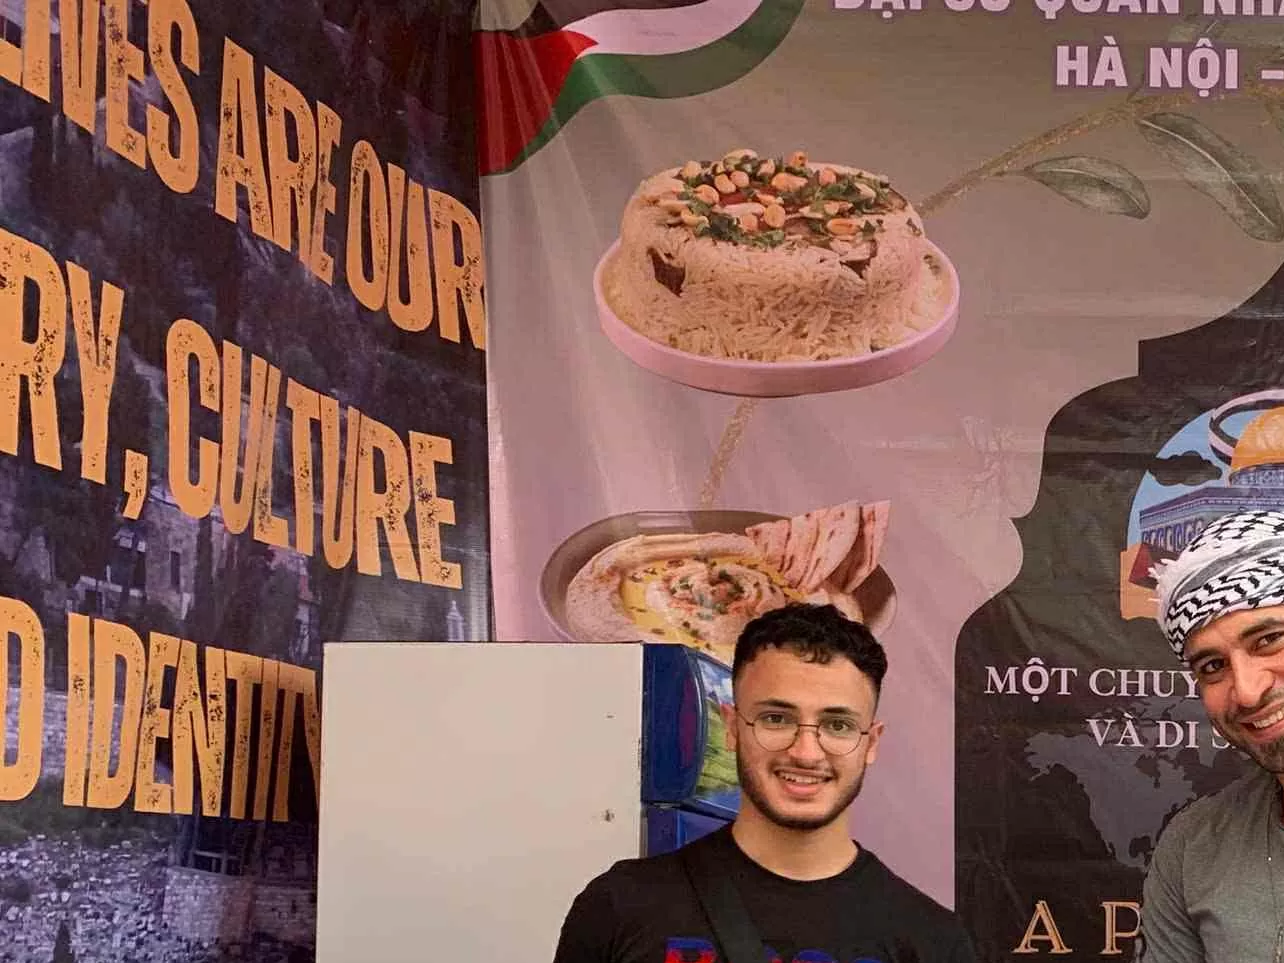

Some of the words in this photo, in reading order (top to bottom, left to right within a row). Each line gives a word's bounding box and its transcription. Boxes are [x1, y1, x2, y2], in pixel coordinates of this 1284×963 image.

[1056, 36, 1128, 87] HÀ
[1149, 38, 1238, 97] NỘI
[214, 36, 341, 286] ARE
[346, 140, 487, 350] OUR
[165, 318, 462, 589] CULTURE
[984, 657, 1077, 703] MỘT
[1089, 668, 1200, 698] CHUY
[1086, 711, 1144, 748] VÀ
[1155, 720, 1200, 748] DI
[1011, 900, 1073, 954] A
[1101, 901, 1142, 954] P
